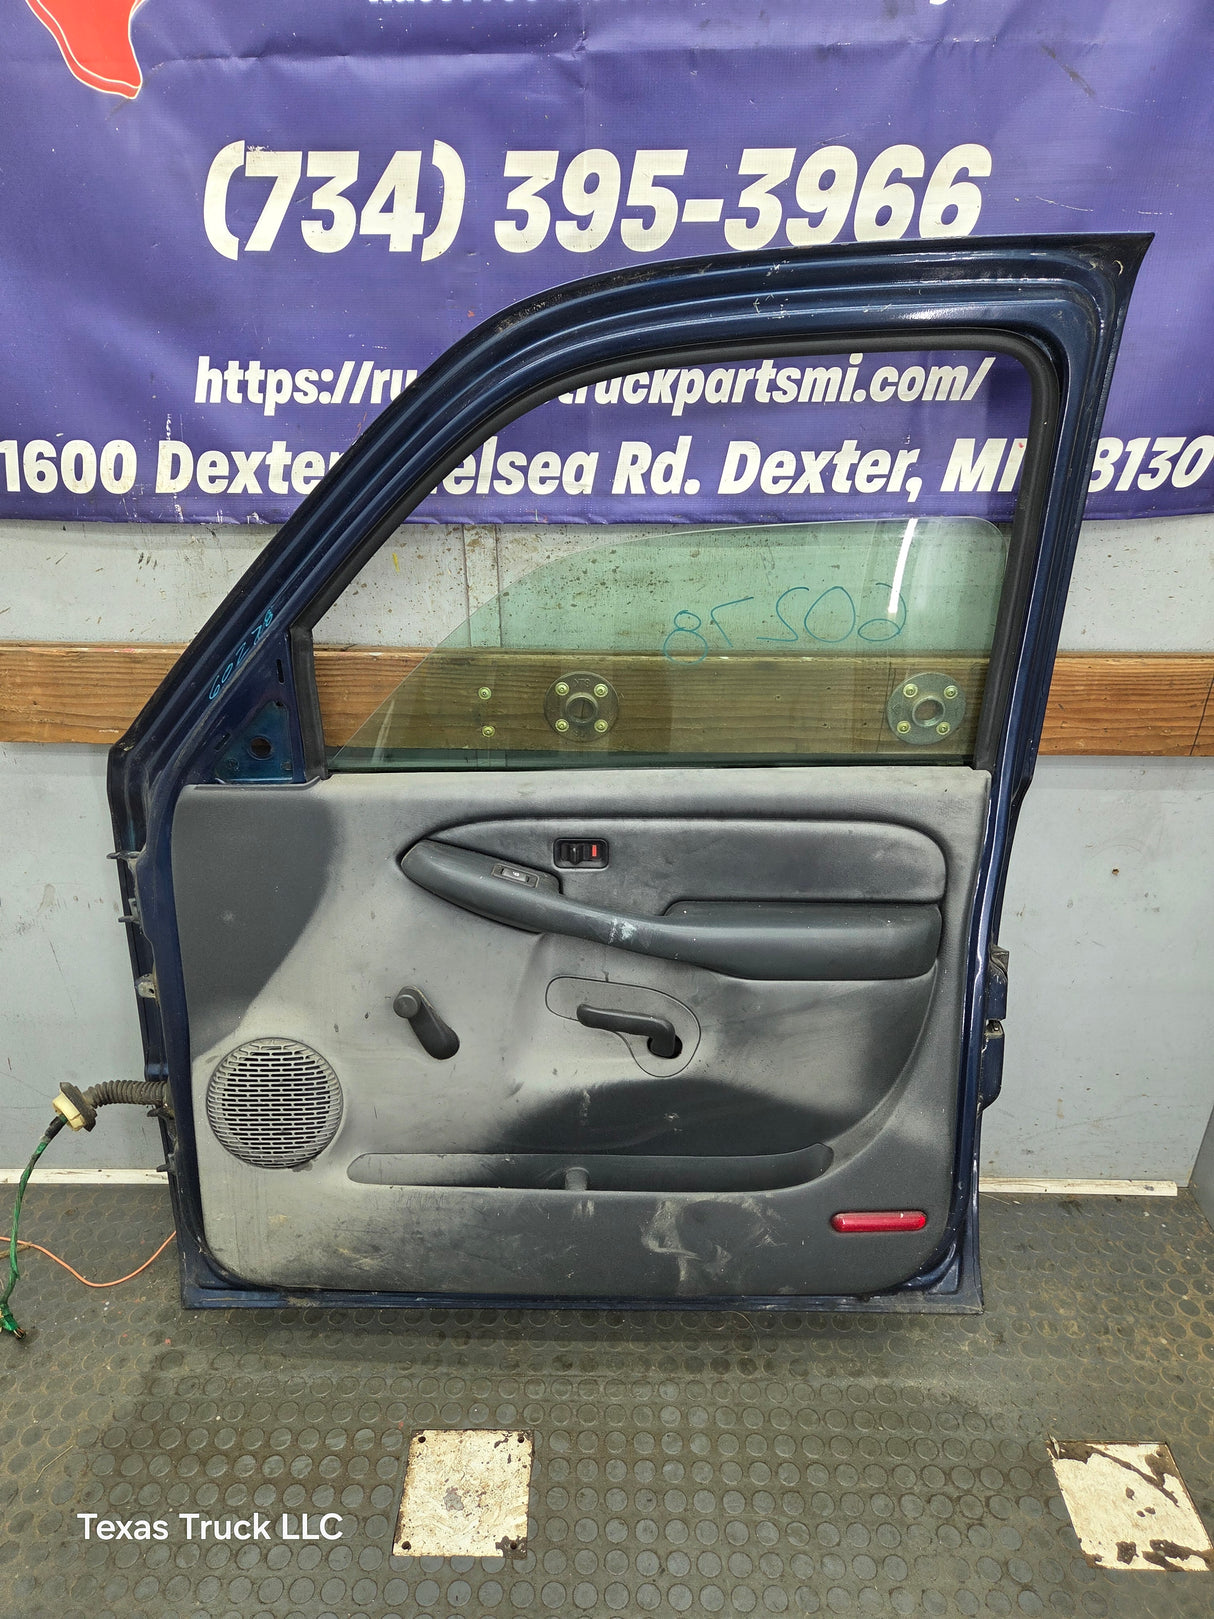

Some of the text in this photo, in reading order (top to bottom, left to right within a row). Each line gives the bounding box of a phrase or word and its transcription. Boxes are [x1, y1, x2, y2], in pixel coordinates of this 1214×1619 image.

[203, 139, 993, 262] (734) 395-3966
[0, 439, 138, 495] 1600
[430, 435, 601, 496] elsea
[611, 435, 701, 495] Rd.
[717, 439, 923, 503] Dexter,
[939, 437, 1028, 493] MI
[1087, 434, 1214, 494] 8130
